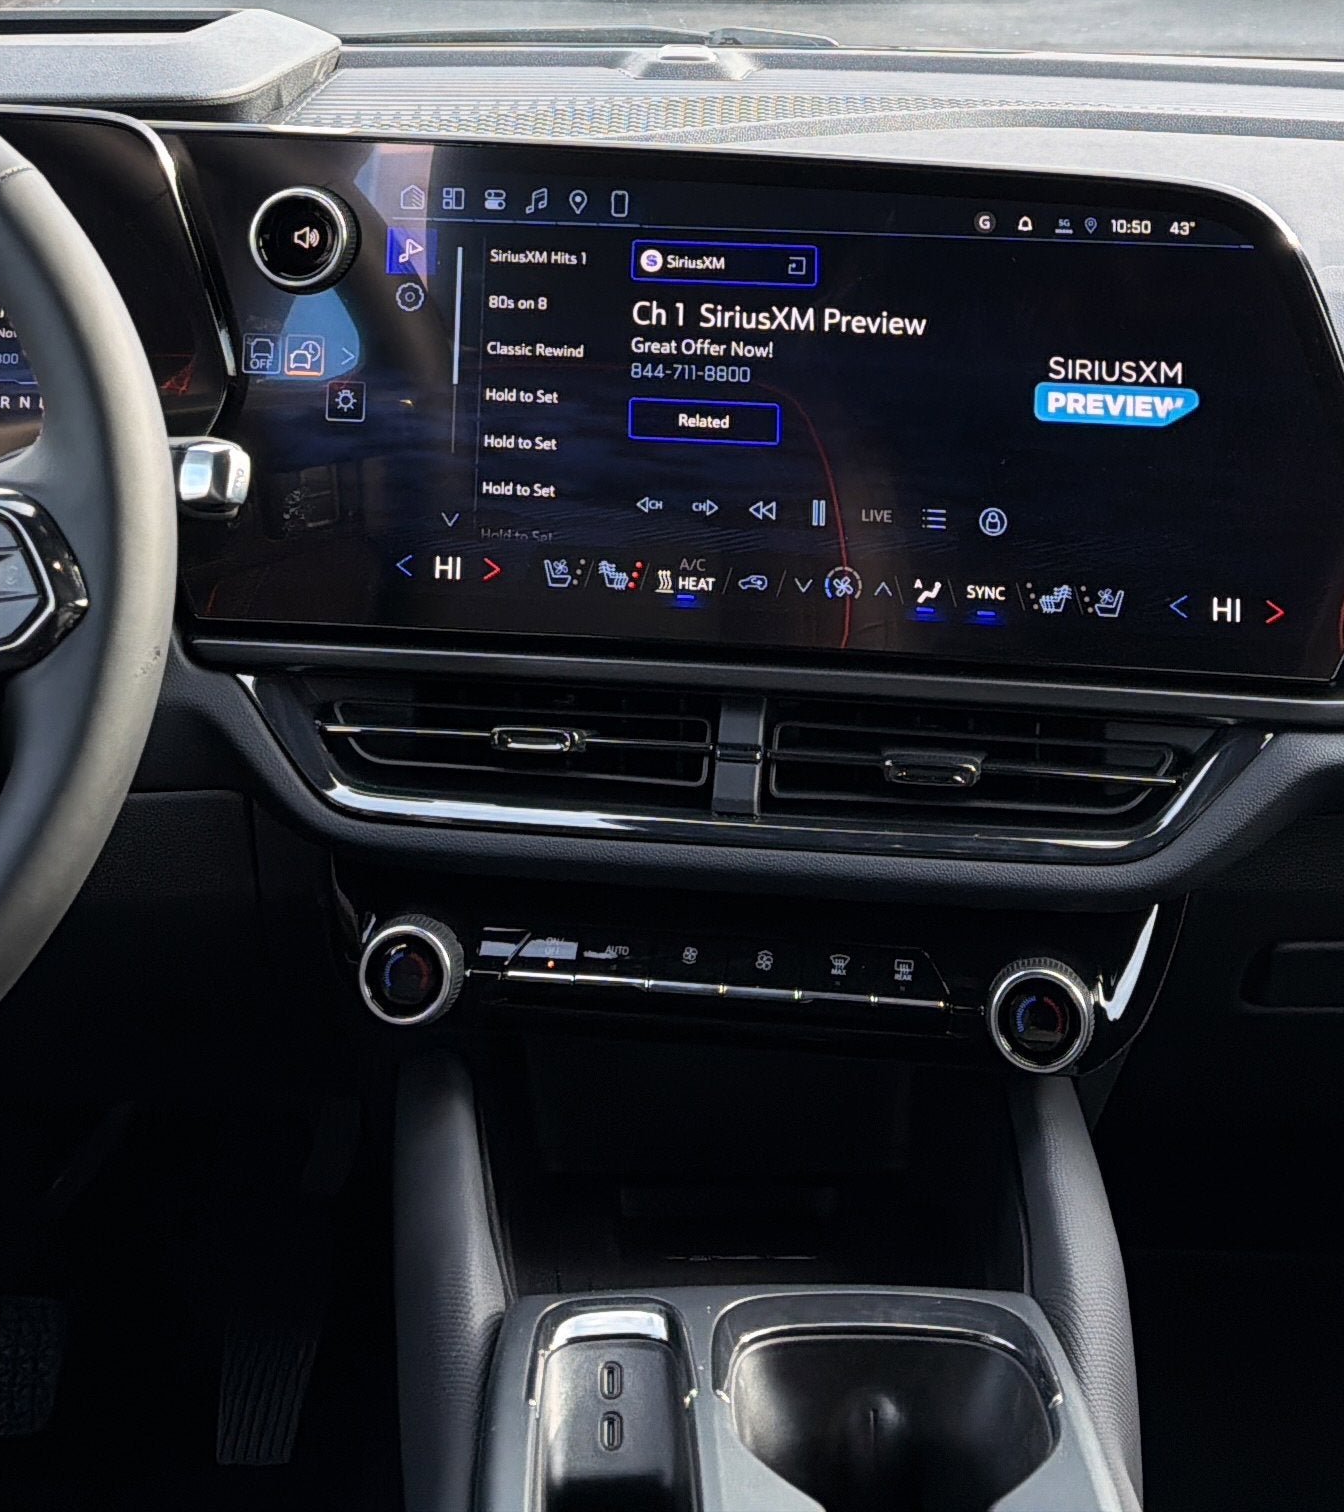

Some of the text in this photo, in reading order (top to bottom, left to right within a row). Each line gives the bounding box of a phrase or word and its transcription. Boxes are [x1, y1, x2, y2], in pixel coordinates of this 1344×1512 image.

[978, 215, 992, 231] G
[1110, 218, 1152, 235] 10:50
[1169, 220, 1196, 237] 43°
[490, 249, 588, 266] SiriusXM Hits 1
[666, 255, 726, 270] SiriusXM
[488, 295, 548, 311] 80s on 8
[632, 300, 927, 337] Ch 1 SiriusXM Preview
[486, 341, 585, 359] Classic Rewind
[630, 337, 775, 359] Great Offer Now!
[249, 358, 274, 371] OFF
[630, 362, 751, 383] 844-711-8800
[1048, 356, 1184, 385] SIRIUSXM
[0, 396, 11, 409] R
[19, 396, 31, 410] N
[485, 388, 559, 404] Hold to Set
[1046, 391, 1185, 419] PREVIEW
[678, 414, 731, 430] Related
[483, 434, 558, 451] Hold to Set
[481, 481, 556, 498] Hold to Set
[861, 507, 894, 525] LIVE
[434, 555, 461, 581] HI
[679, 557, 706, 572] A/C
[678, 576, 716, 592] HEAT
[966, 584, 1006, 601] SYNC
[1211, 596, 1242, 624] HI
[605, 945, 630, 956] AUTO
